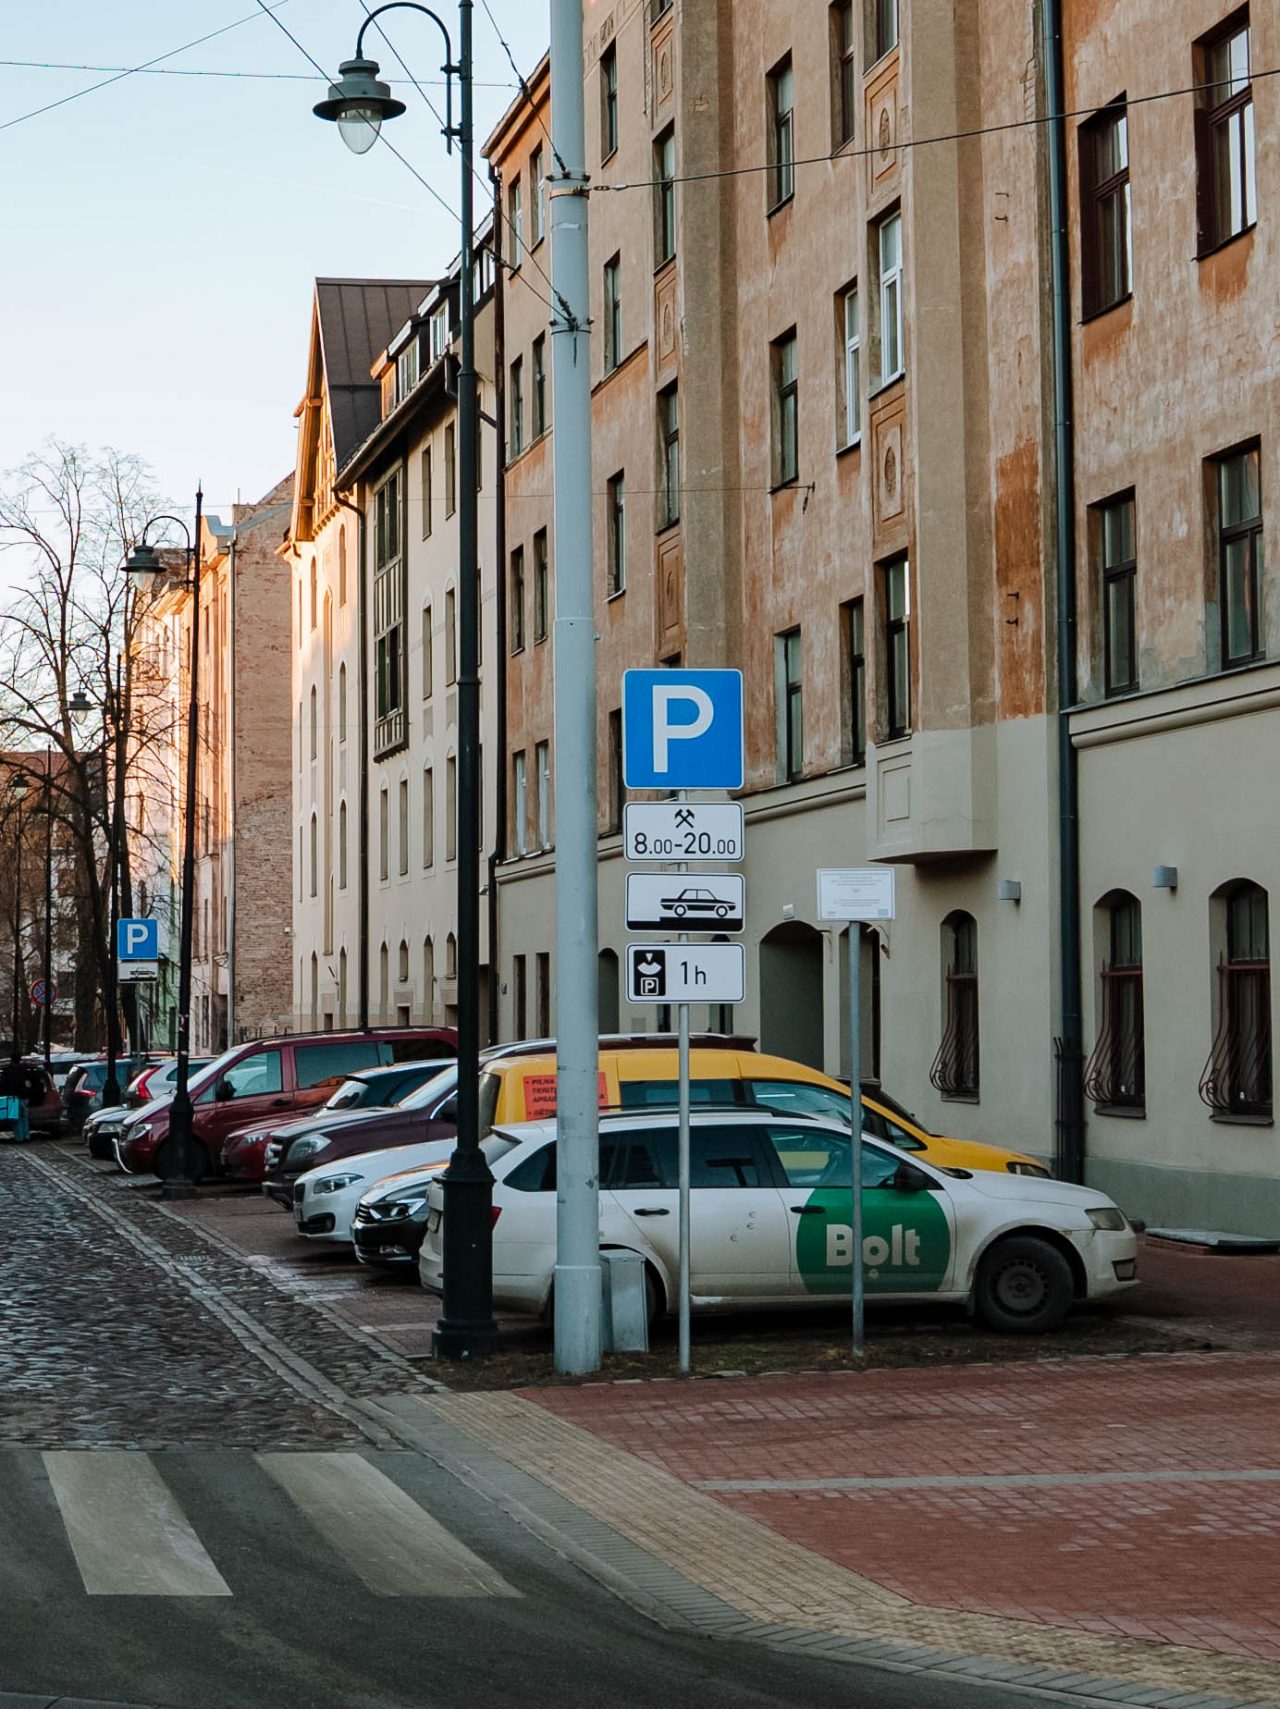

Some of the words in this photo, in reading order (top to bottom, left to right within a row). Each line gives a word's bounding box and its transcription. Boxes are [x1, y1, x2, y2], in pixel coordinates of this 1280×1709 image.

[652, 685, 715, 773] P
[634, 832, 736, 855] 8.00-20.00
[127, 923, 149, 954] P
[644, 980, 655, 993] P
[826, 1223, 921, 1279] Bolt
